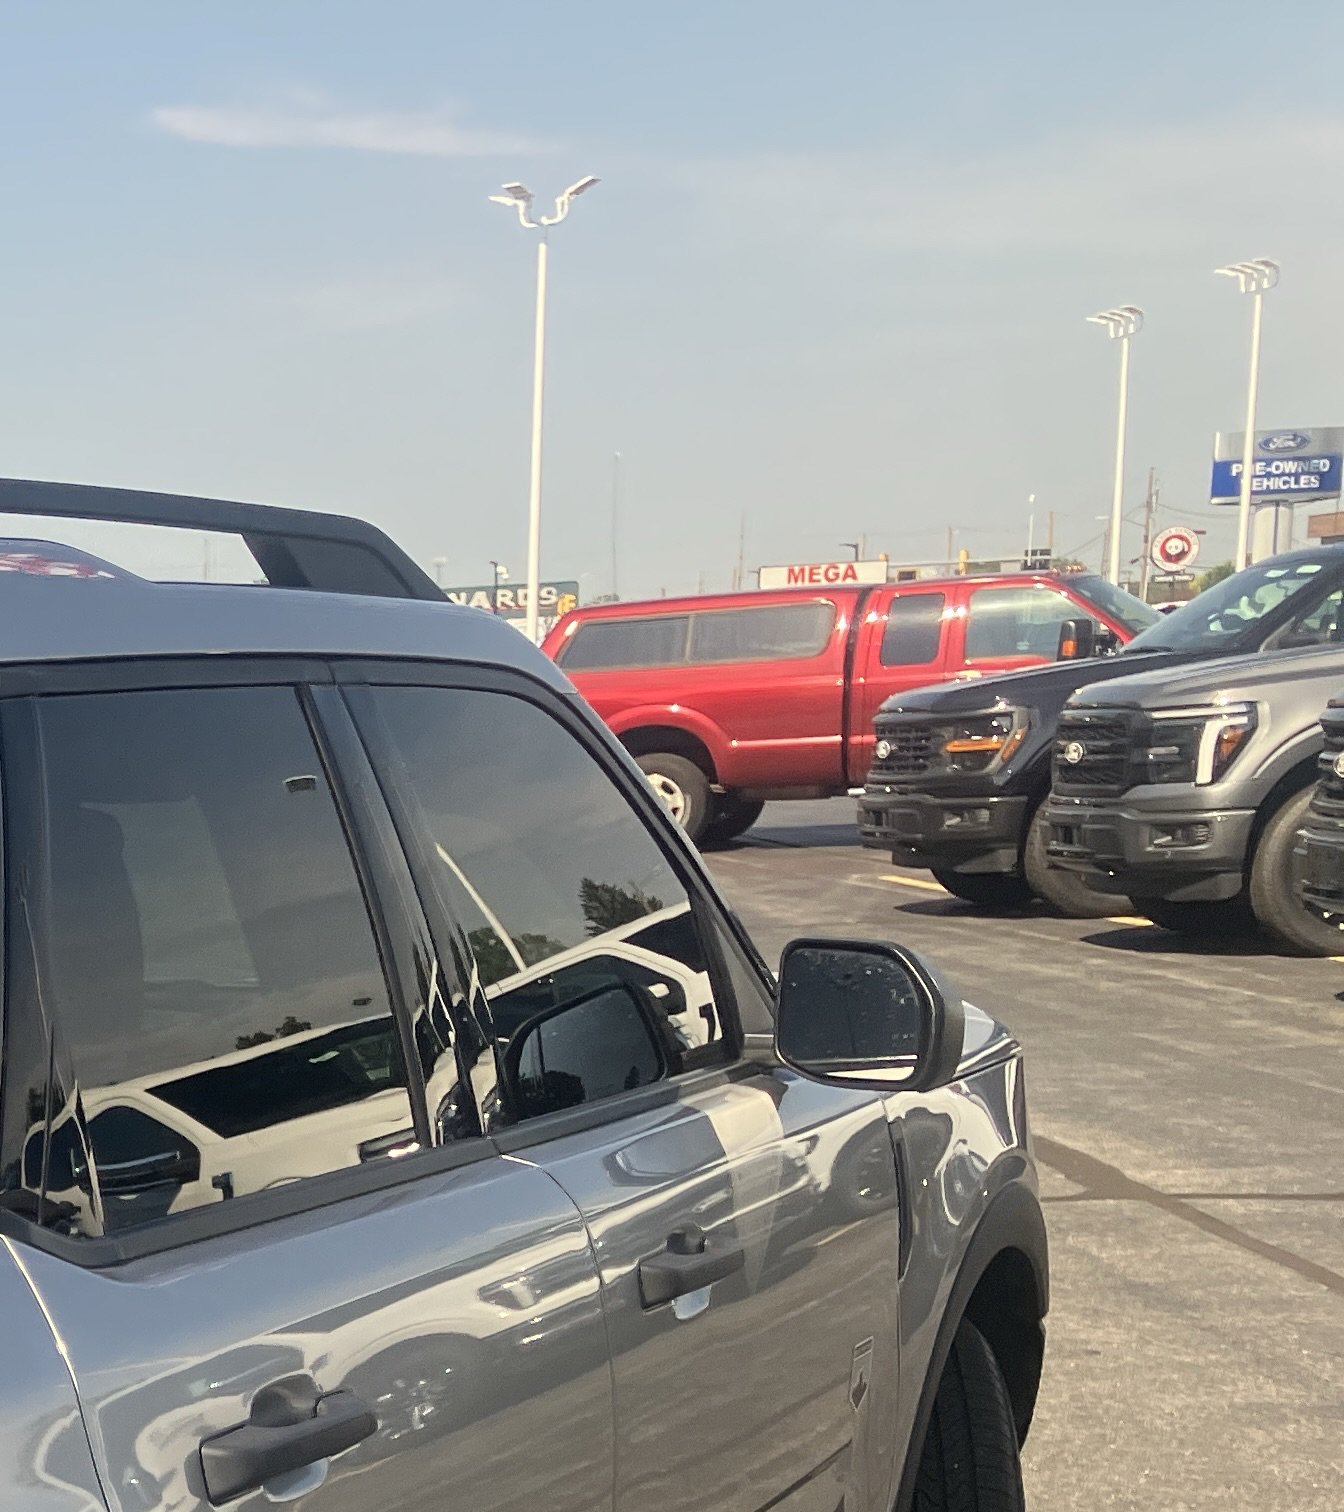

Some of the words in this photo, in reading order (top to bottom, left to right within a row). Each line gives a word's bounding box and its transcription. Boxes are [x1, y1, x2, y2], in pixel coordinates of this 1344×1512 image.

[1231, 459, 1330, 477] PE-OWNED
[1241, 475, 1321, 491] EHICLES
[787, 564, 858, 585] MEGA
